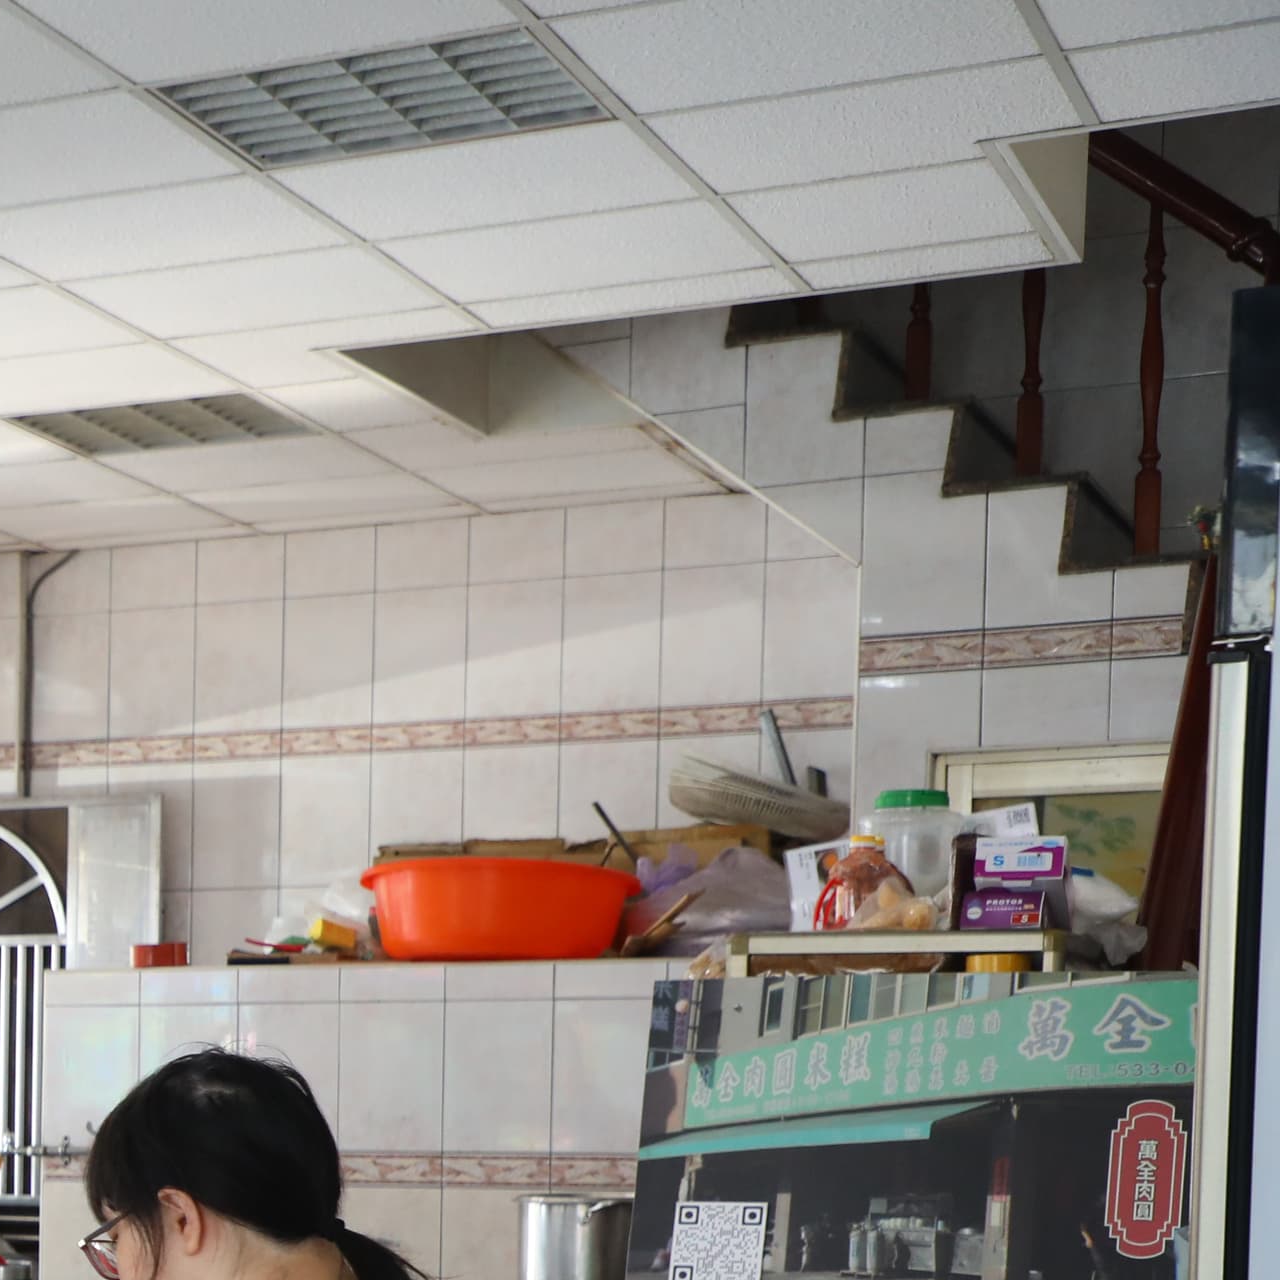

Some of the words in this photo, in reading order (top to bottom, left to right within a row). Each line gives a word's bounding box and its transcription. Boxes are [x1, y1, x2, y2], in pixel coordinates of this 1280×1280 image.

[993, 855, 1005, 867] S
[1116, 1061, 1196, 1078] 533-0
[1132, 1139, 1159, 1221] 萬全肉圓
